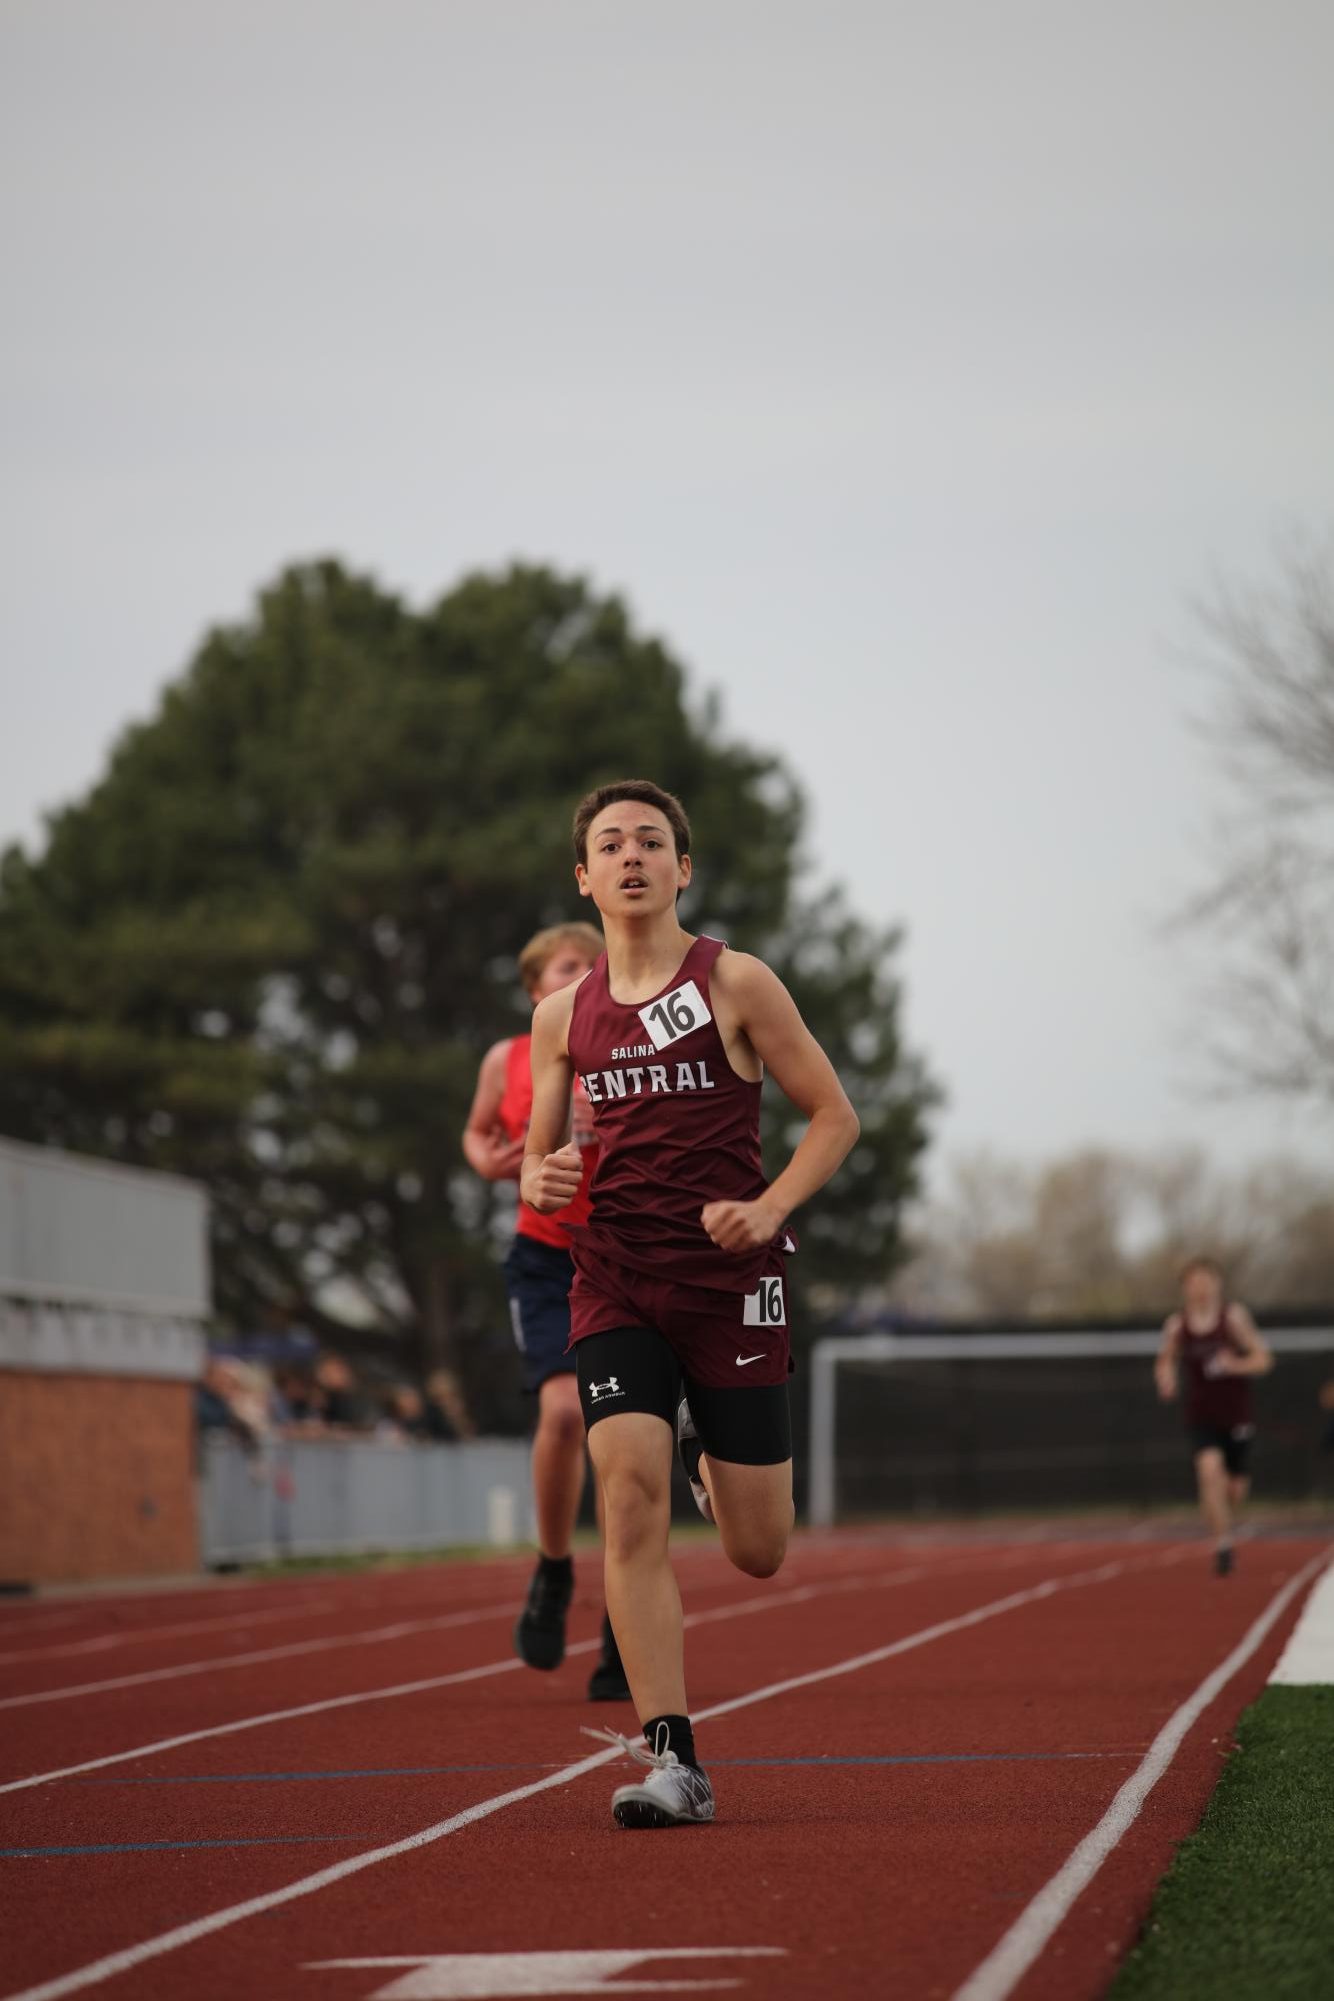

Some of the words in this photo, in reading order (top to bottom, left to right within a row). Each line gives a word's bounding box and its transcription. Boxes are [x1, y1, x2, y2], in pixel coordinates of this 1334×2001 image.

[649, 991, 696, 1040] 16
[612, 1045, 655, 1060] SALINA
[759, 1279, 782, 1323] 16
